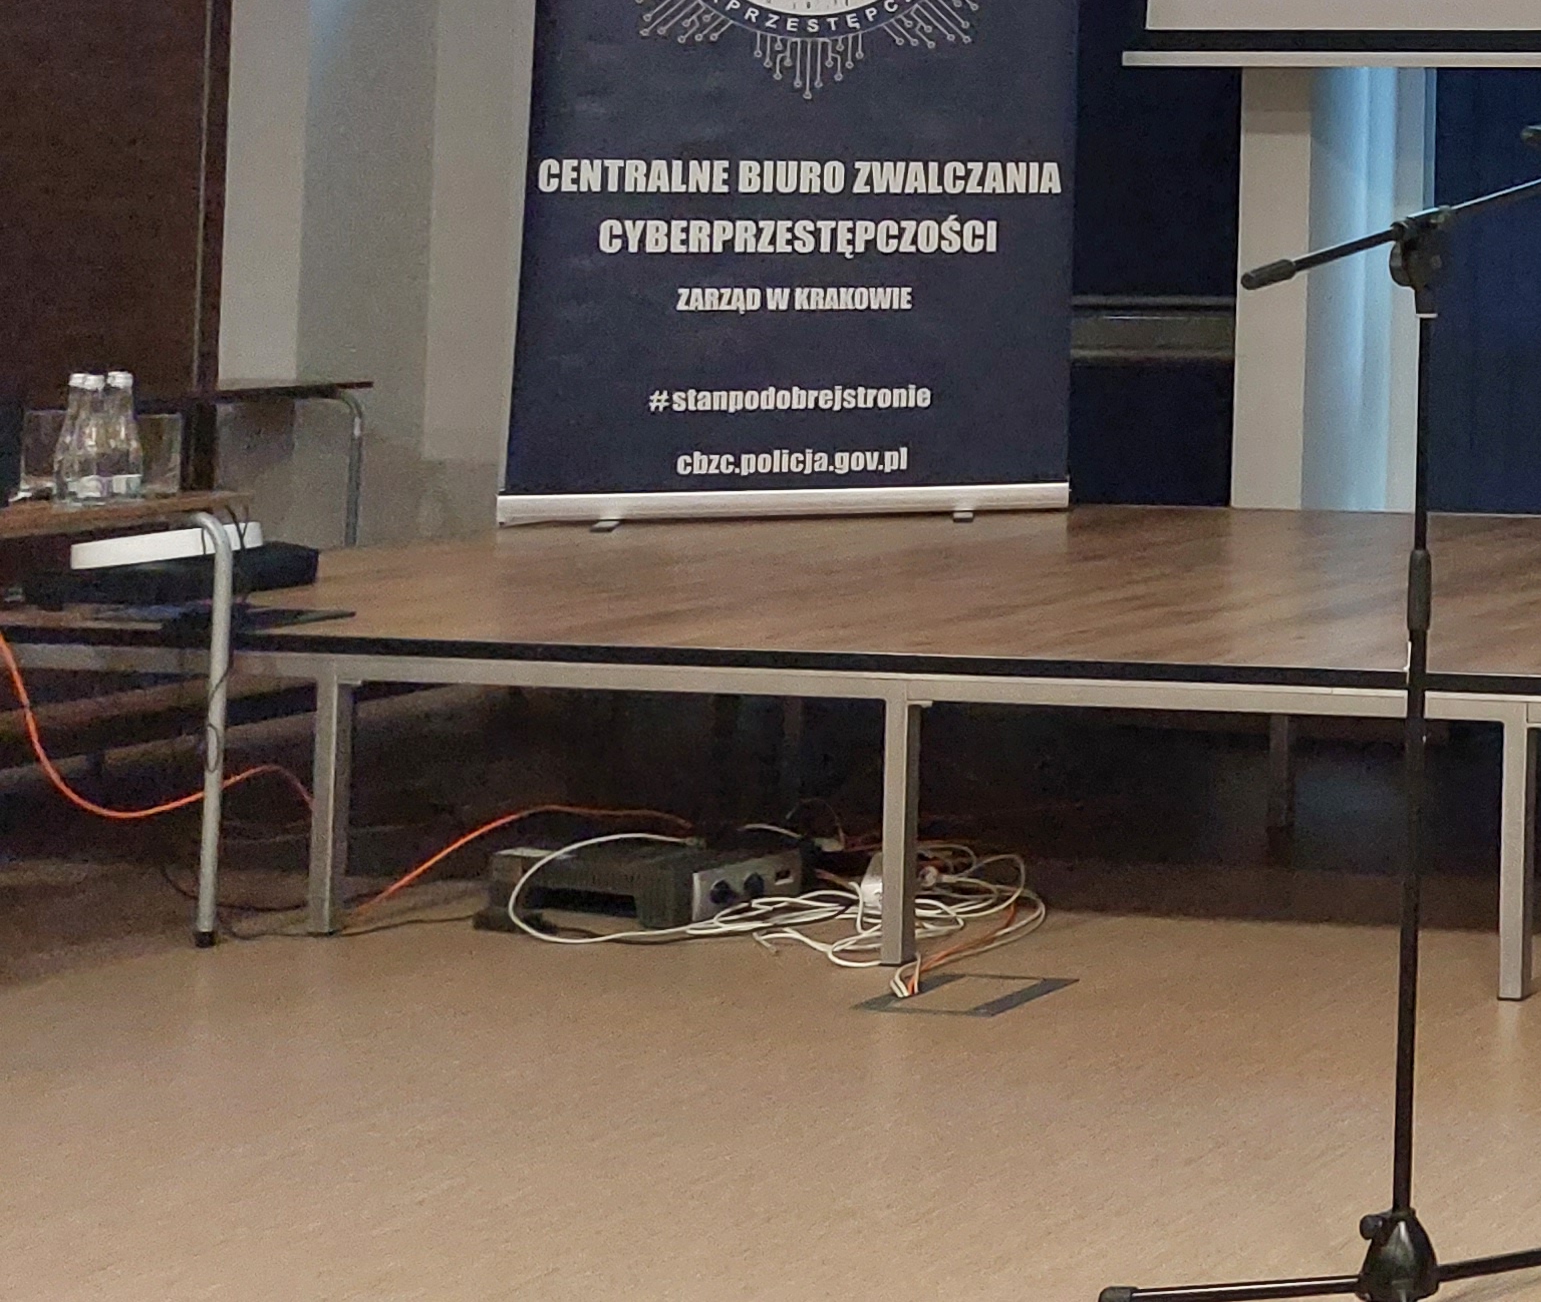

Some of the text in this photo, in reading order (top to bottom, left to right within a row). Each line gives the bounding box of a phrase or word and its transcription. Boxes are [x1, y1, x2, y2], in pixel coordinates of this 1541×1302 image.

[538, 158, 1062, 194] CENTRALNE BIURO ZWALCZANIA
[599, 214, 997, 259] CYBERPRZESTĘPCZOŚCI
[676, 287, 913, 315] ZARZĄD W KRAKOWIE
[648, 384, 932, 414] #stanpodobrejstronie
[676, 446, 908, 477] cbzc.policja.gov.pl
